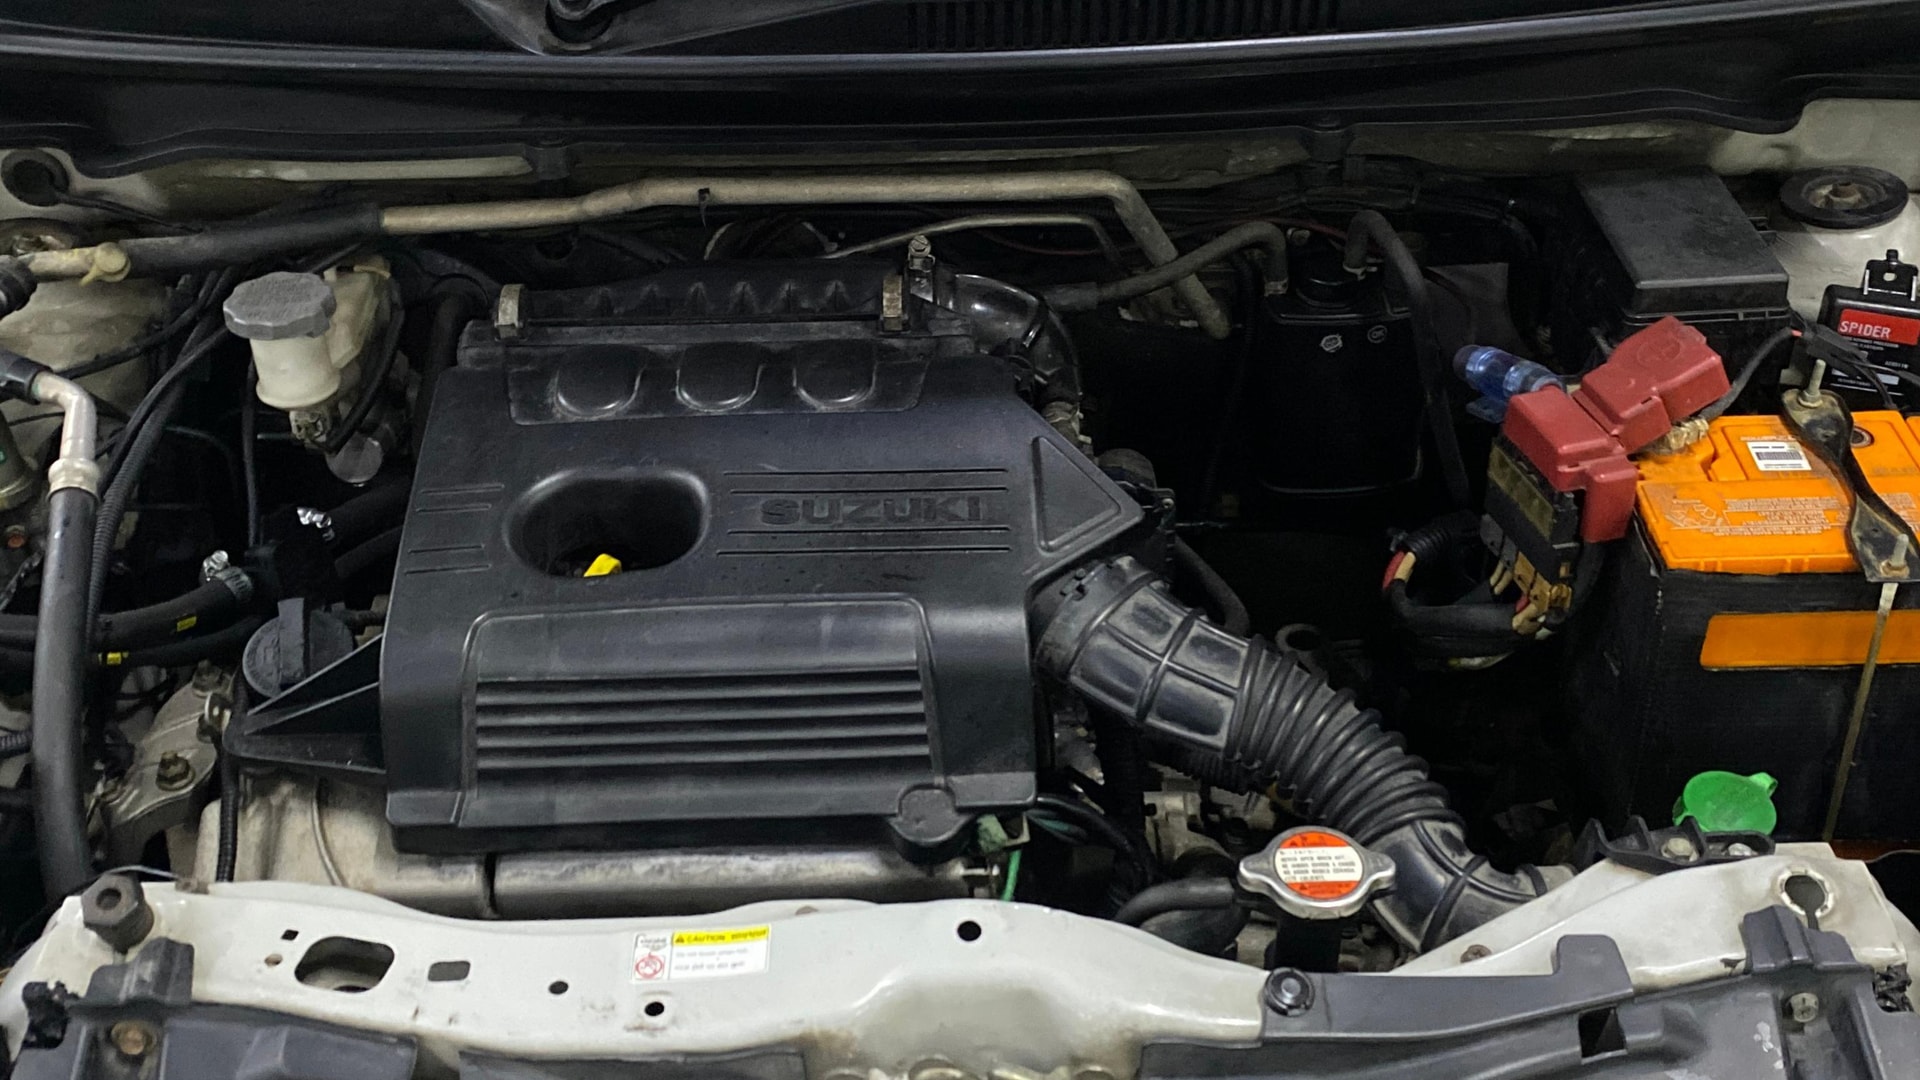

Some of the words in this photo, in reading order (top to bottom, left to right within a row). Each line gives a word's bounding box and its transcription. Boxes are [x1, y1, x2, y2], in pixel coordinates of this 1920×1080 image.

[1839, 320, 1891, 339] SPIDER
[760, 495, 982, 525] SUZUKI
[686, 934, 726, 943] CAUTION
